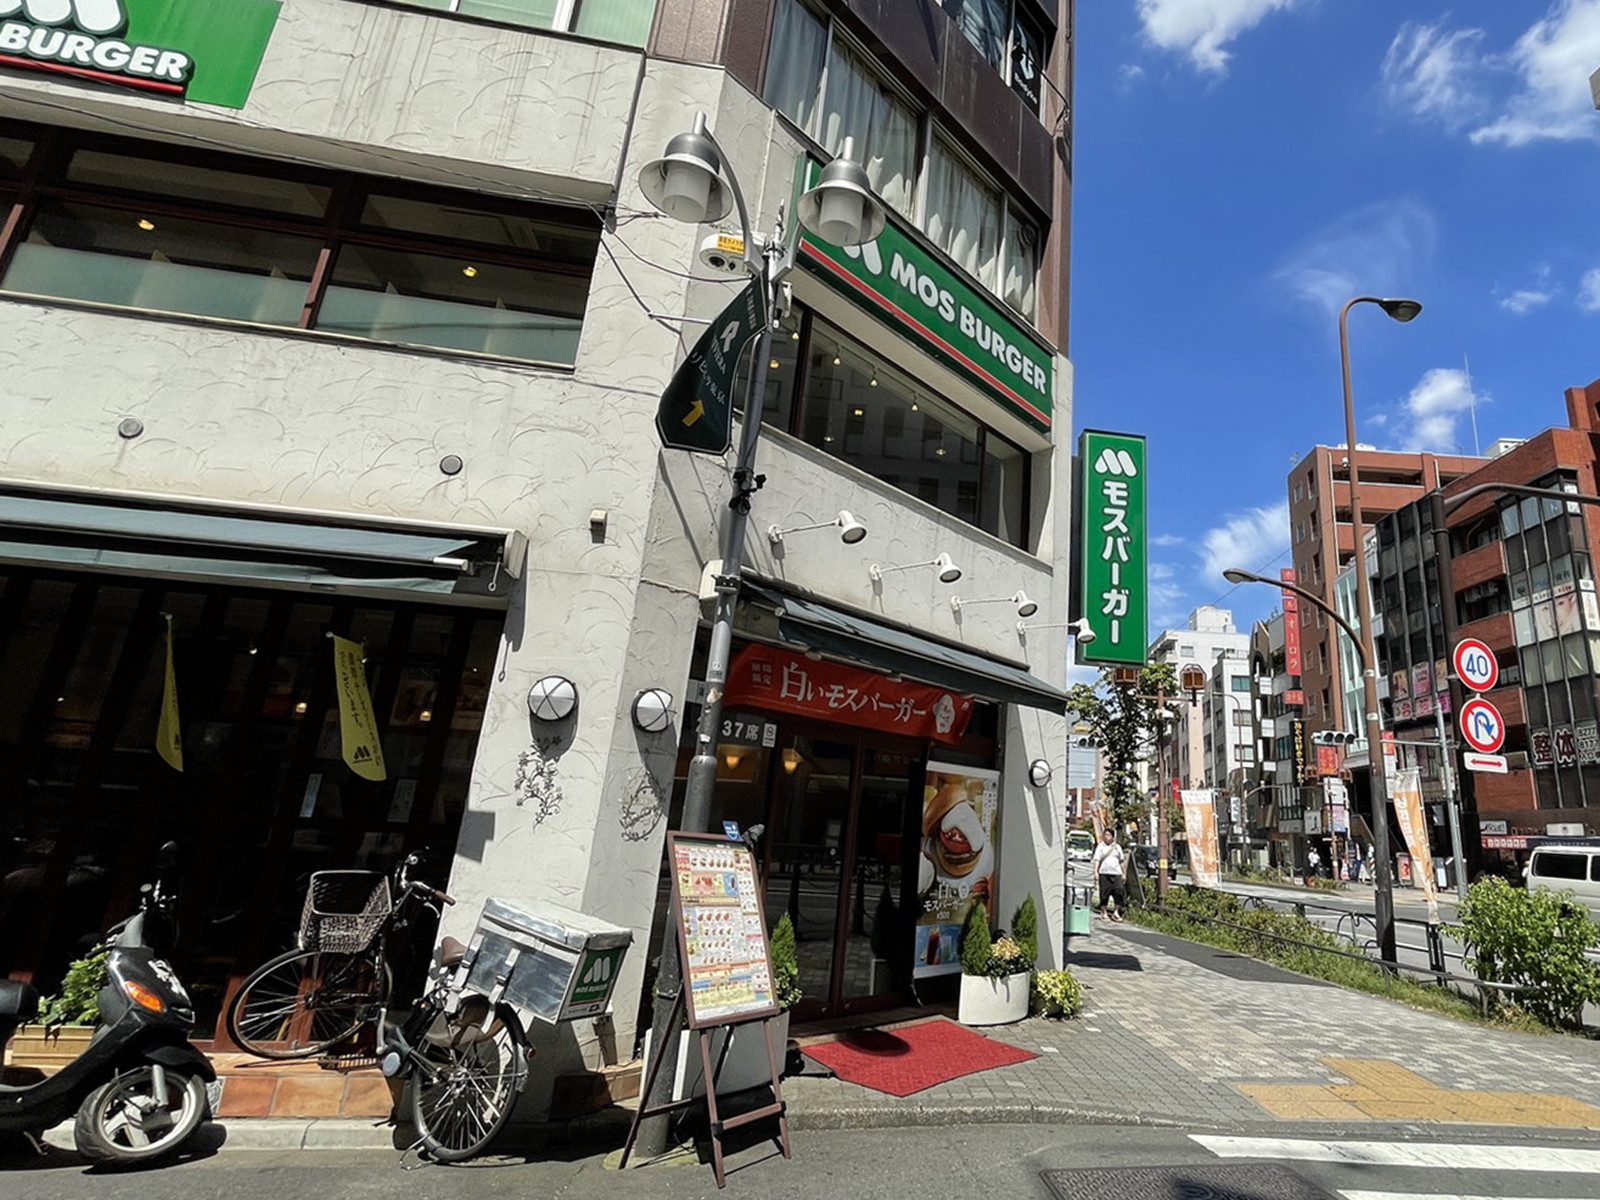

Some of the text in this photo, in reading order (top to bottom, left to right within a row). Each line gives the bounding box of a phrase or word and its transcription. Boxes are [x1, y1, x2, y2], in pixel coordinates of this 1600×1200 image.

[0, 22, 188, 79] BURGER
[890, 252, 1048, 395] MOS BURGER
[1102, 480, 1132, 644] モスバーガー
[780, 661, 926, 723] 白いモスバーガー
[1466, 653, 1489, 677] 40
